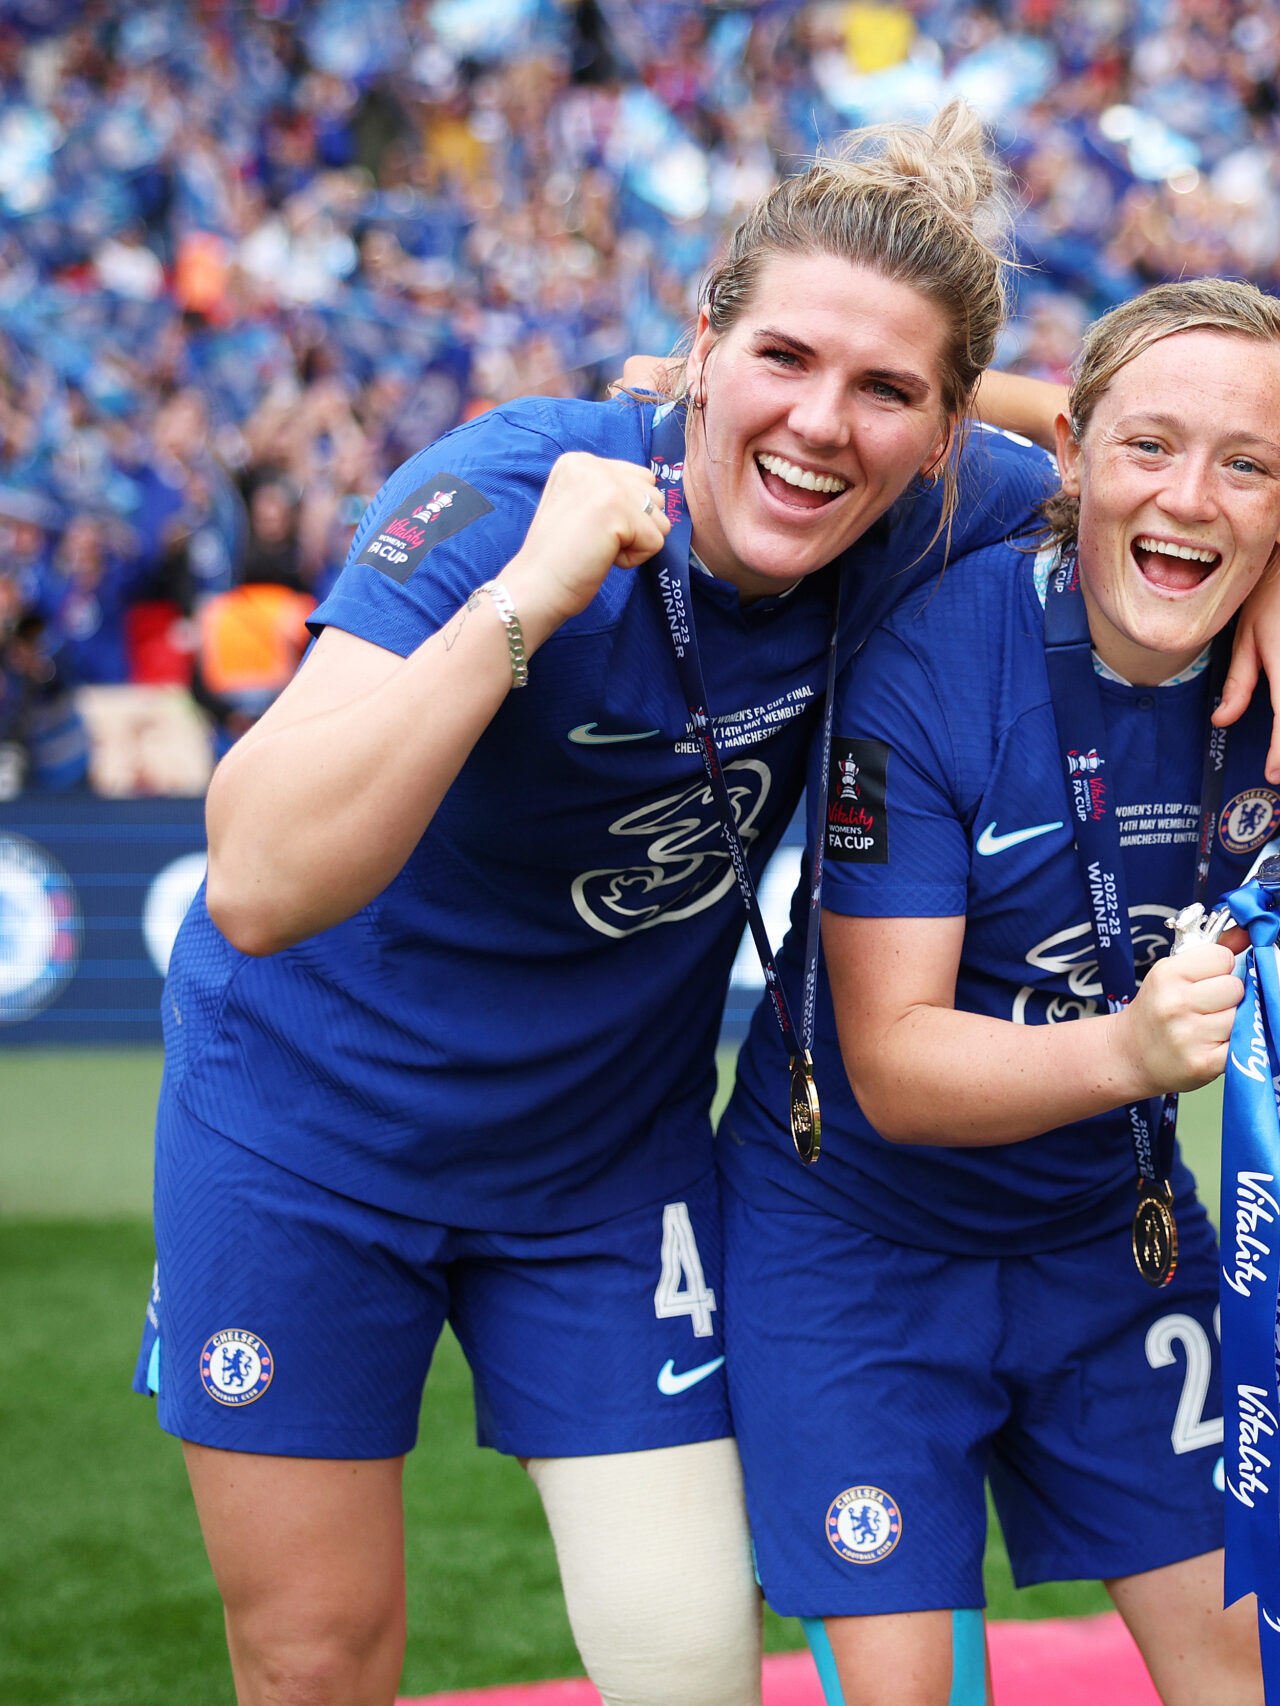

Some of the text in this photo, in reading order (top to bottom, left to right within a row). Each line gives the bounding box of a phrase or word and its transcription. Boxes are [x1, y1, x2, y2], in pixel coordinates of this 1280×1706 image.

[667, 488, 683, 528] Vitalit
[384, 518, 426, 550] Vitality
[367, 541, 409, 564] FA CUP
[1055, 570, 1067, 593] CUP
[658, 568, 685, 658] WINNER
[672, 579, 690, 644] 2022-23
[753, 706, 766, 718] FA
[767, 697, 785, 710] CUP
[786, 685, 814, 702] FINAL
[720, 725, 742, 738] 14TH
[744, 719, 761, 731] MAY
[762, 703, 807, 724] WEMBLEY
[674, 742, 701, 754] CHELS
[715, 741, 723, 750] V
[1072, 780, 1087, 821] FA CUP
[1089, 777, 1107, 820] Vitality
[1153, 804, 1164, 815] FA
[1164, 803, 1182, 815] CUP
[828, 802, 874, 832] Vitality
[829, 824, 862, 835] WOMEN'S
[1119, 818, 1198, 832] 14TH MAY WEMBLEY
[829, 834, 875, 850] FA CUP
[1119, 833, 1172, 847] MANCHESTER
[1087, 861, 1111, 948] WINNER
[1103, 873, 1121, 935] 2022-23
[1129, 1106, 1150, 1178] WINNE
[1222, 1171, 1280, 1297] Vitality
[654, 1201, 717, 1338] 4
[212, 1331, 260, 1351] CHELSEA
[1145, 1303, 1225, 1455] 2
[1226, 1384, 1279, 1508] Vitality
[835, 1489, 884, 1510] CHELSEA
